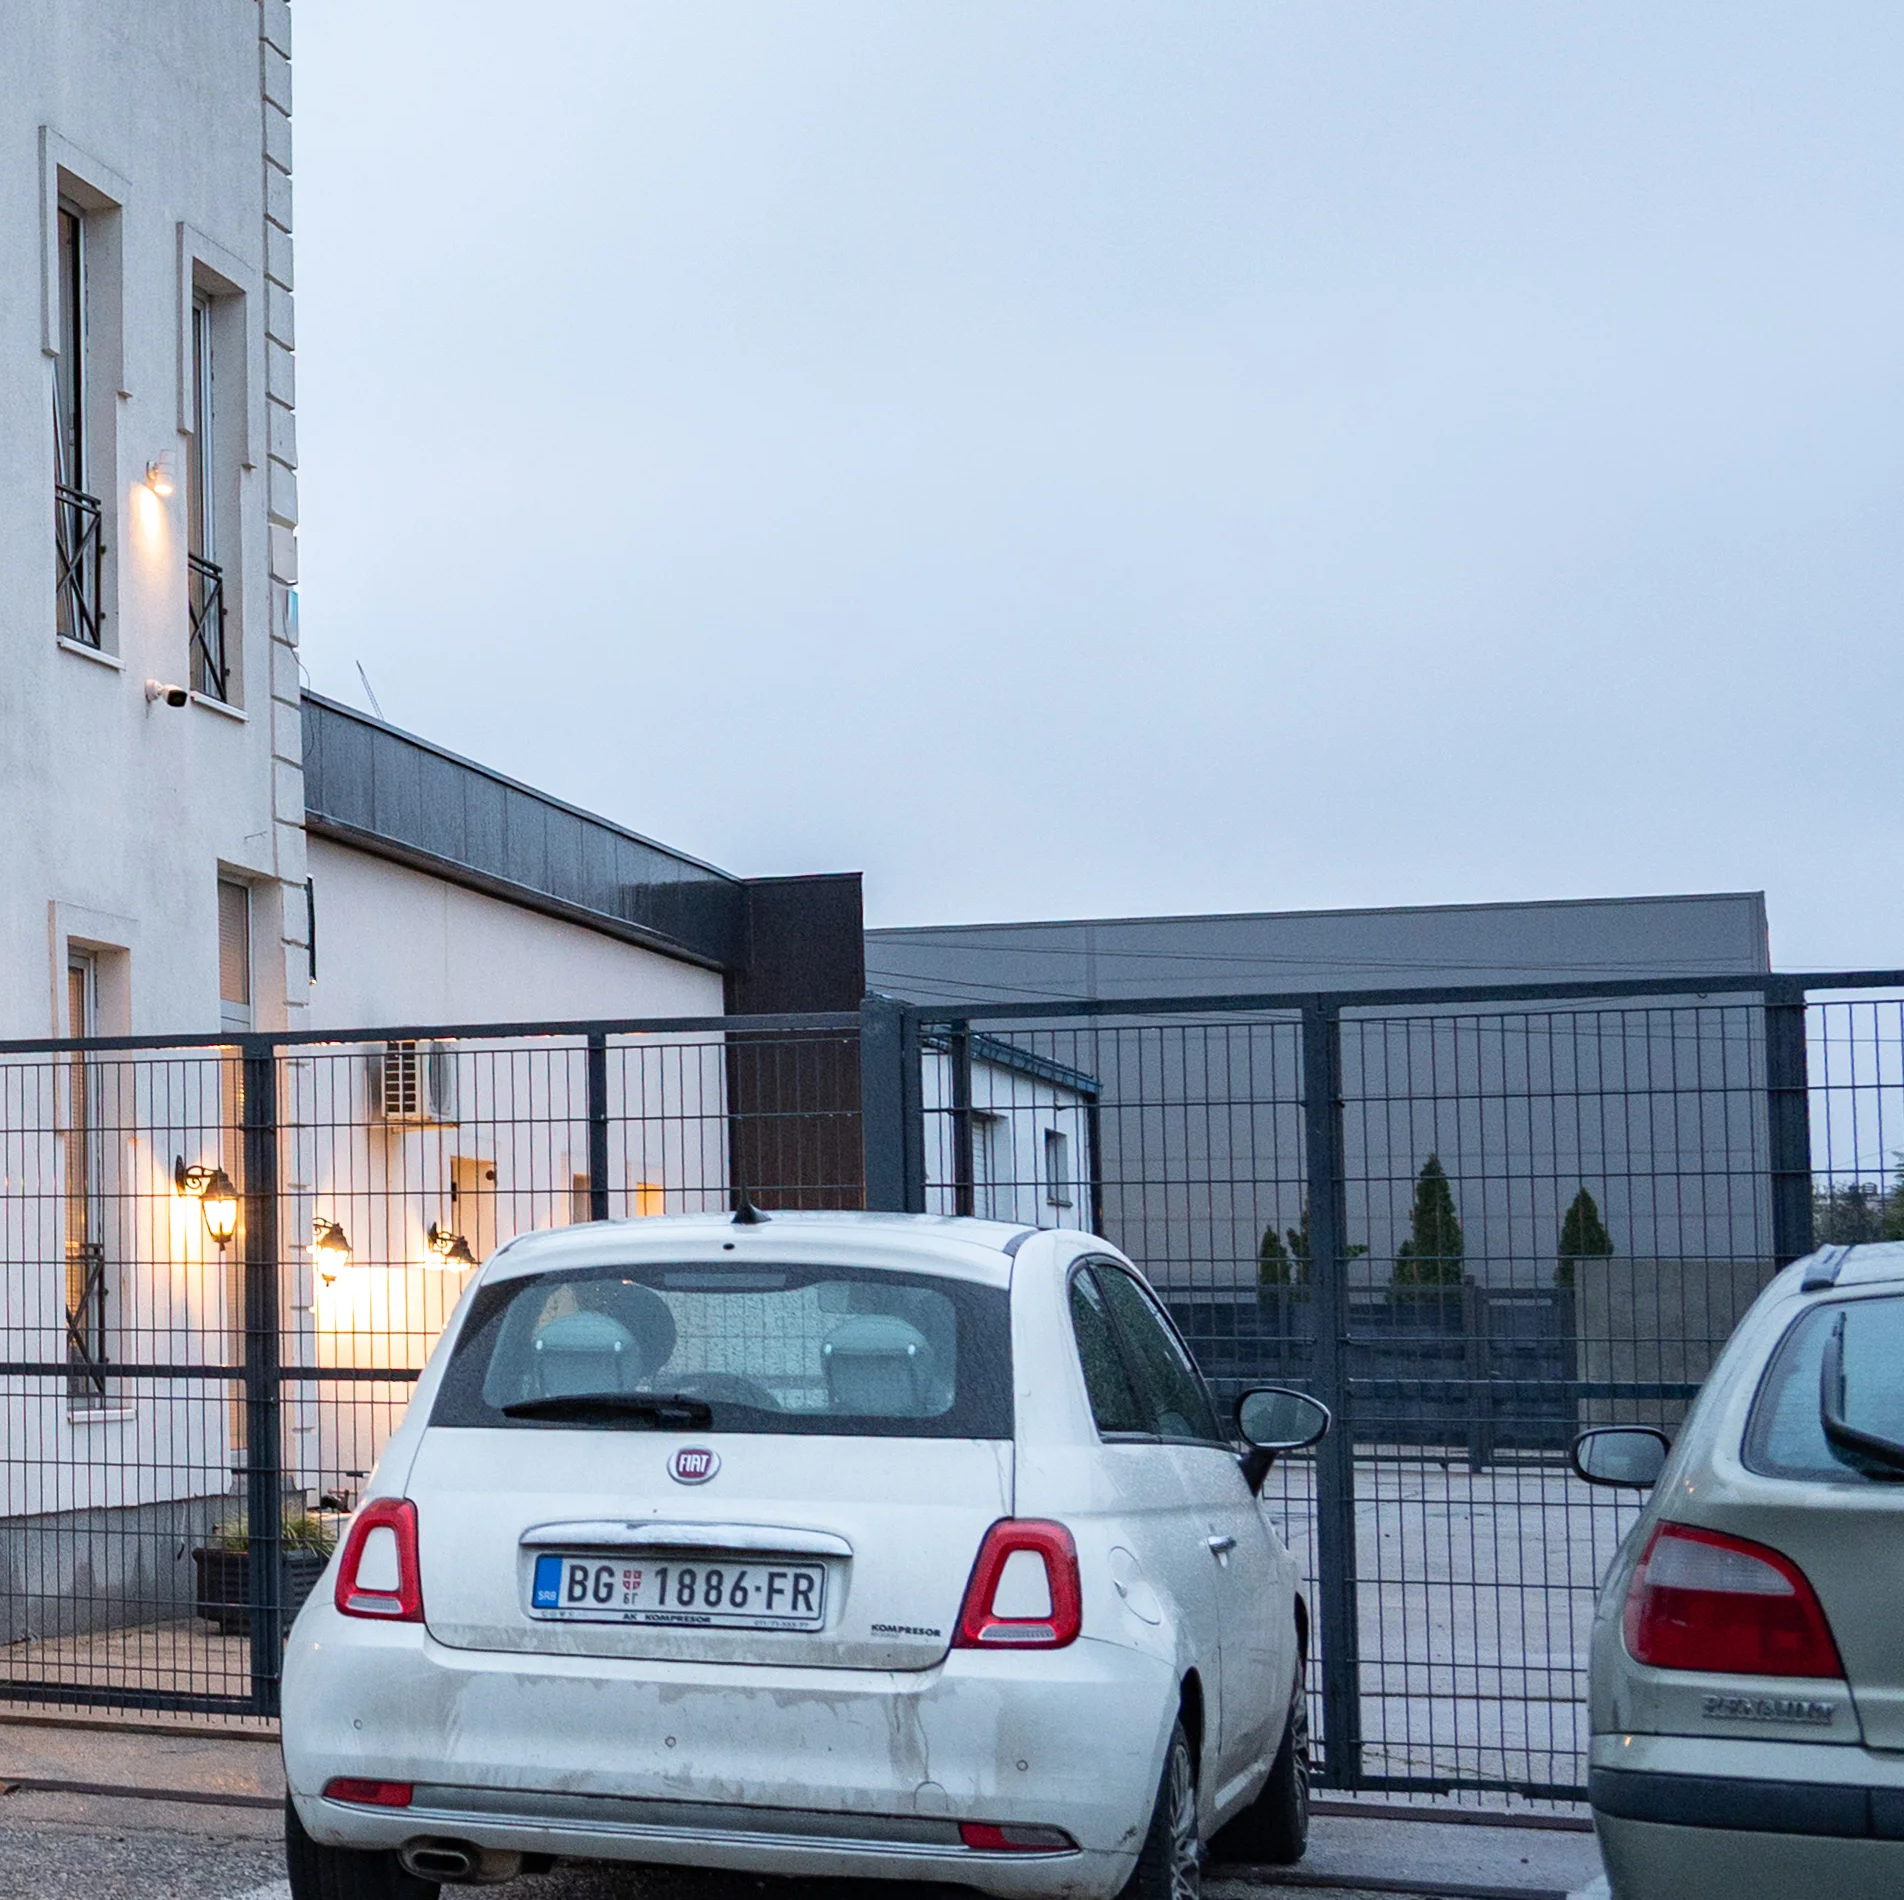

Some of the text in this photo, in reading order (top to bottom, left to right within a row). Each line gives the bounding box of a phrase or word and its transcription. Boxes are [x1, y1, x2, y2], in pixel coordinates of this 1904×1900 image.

[678, 1453, 710, 1474] FIAT
[567, 1564, 616, 1604] BG
[537, 1590, 558, 1601] SRB
[622, 1613, 712, 1625] AK KOMPRESOR
[871, 1623, 942, 1638] KOMPRESOR
